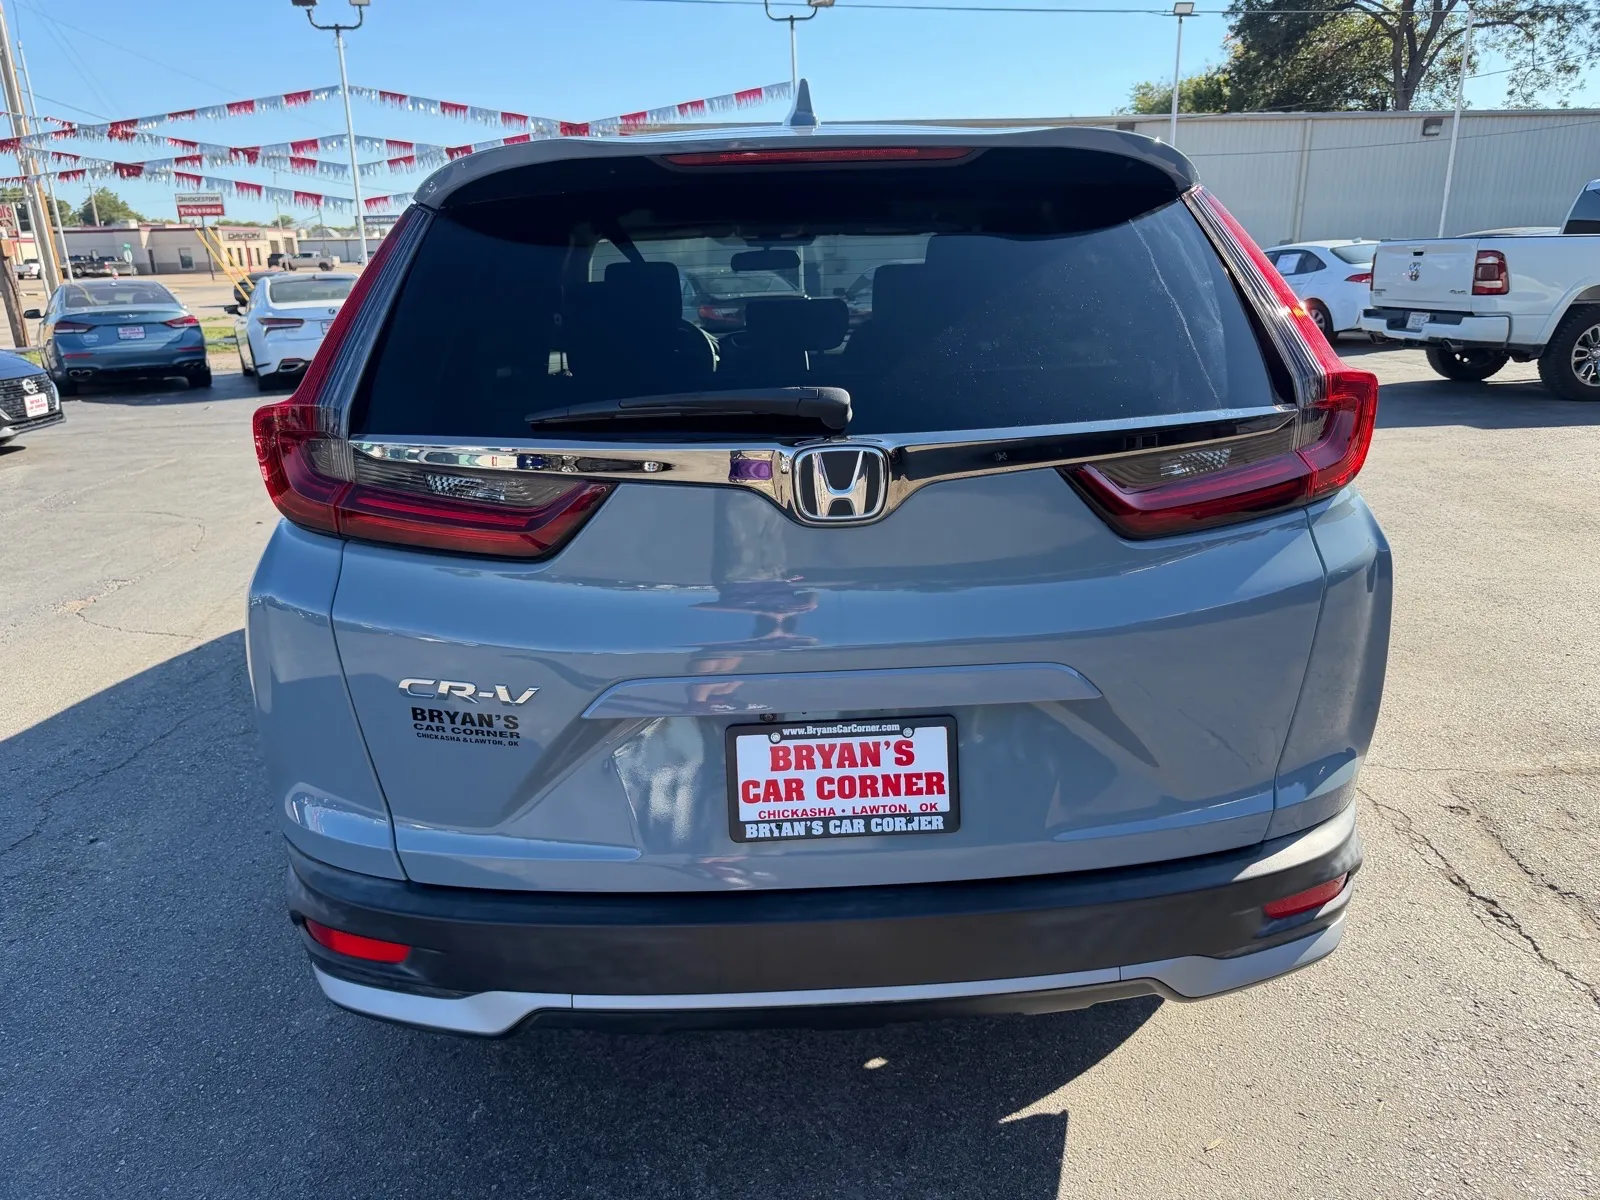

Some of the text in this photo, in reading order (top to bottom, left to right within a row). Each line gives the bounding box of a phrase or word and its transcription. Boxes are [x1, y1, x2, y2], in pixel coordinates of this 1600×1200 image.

[180, 206, 223, 215] Firestone
[398, 676, 541, 706] CR-V
[411, 706, 520, 730] BRYAN'S
[413, 722, 521, 739] CAR CORNER
[416, 732, 461, 743] CHICKASHA
[782, 723, 901, 736] www.BryansCarCorner.com
[769, 740, 915, 772] BRYAN'S
[741, 771, 946, 804] CAR CORNER
[758, 802, 938, 820] CHICKASHA LAWTON, OK
[745, 815, 945, 839] BRYAN'S CAR CORNER
